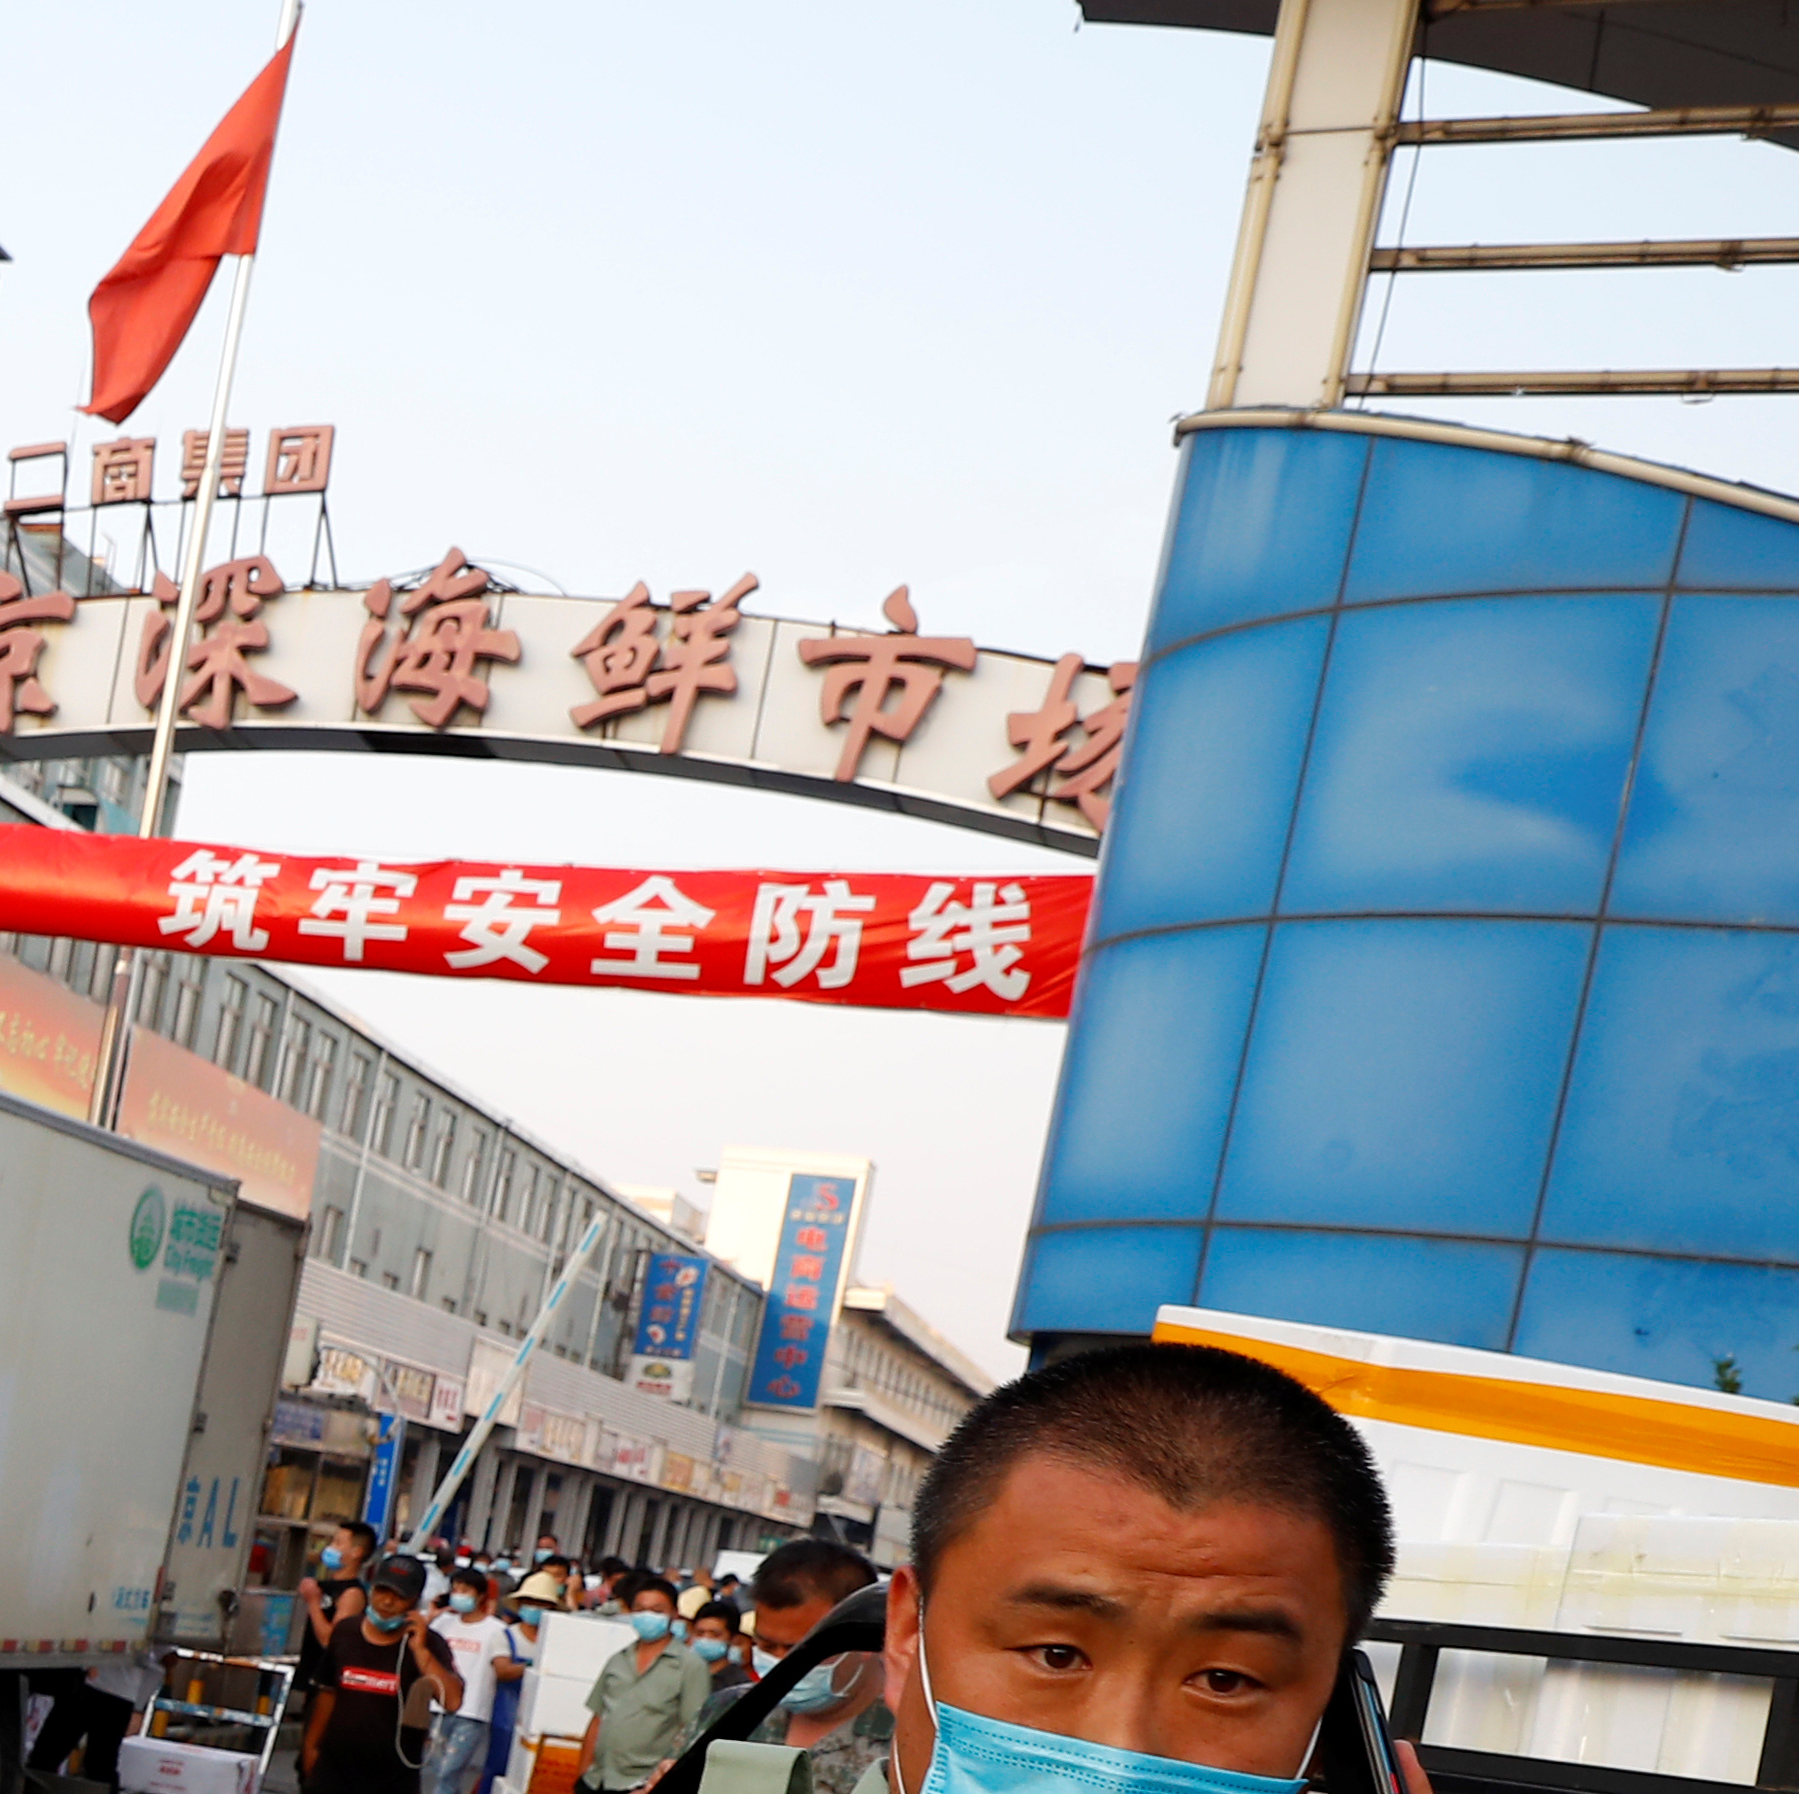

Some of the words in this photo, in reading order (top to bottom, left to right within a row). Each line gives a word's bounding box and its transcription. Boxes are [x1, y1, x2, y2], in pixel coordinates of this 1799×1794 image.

[157, 849, 1032, 1003] 筑牢安全防线
[766, 1225, 829, 1399] 电商运营中心
